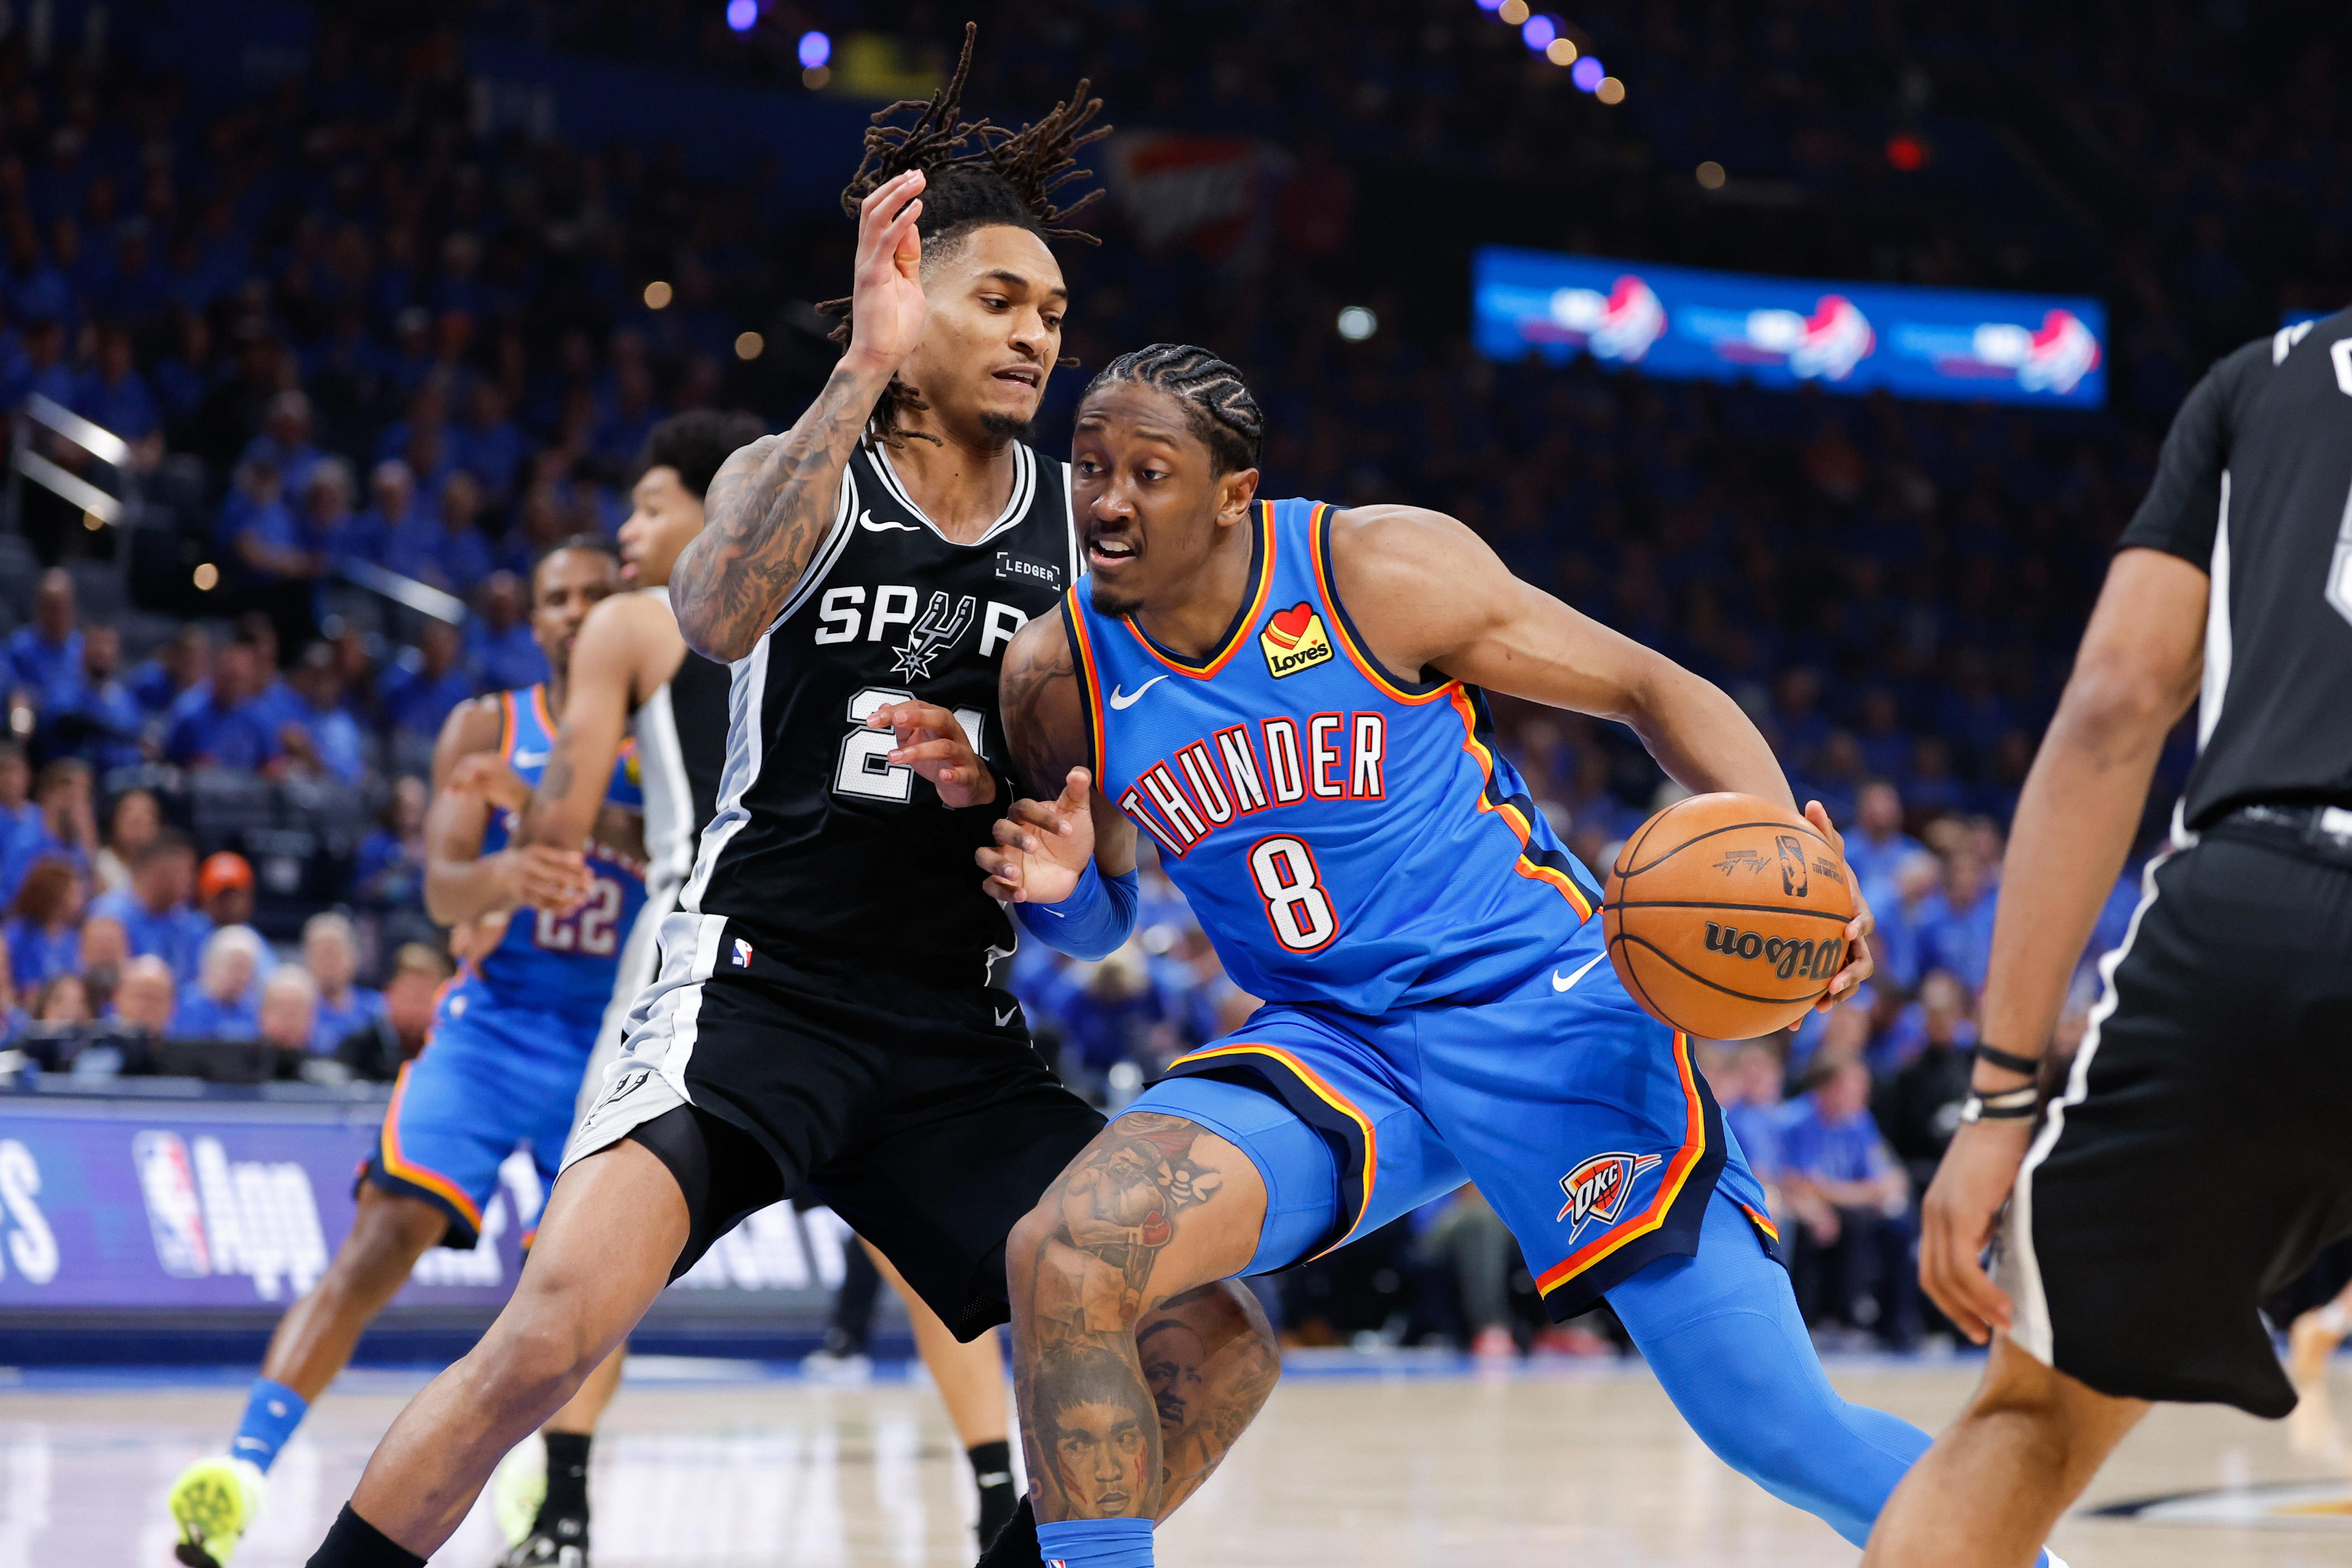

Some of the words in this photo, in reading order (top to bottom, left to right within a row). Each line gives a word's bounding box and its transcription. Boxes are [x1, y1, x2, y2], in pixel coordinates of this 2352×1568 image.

[1005, 559, 1054, 582] LEDGER
[814, 585, 1030, 684] SPUR
[1117, 711, 1387, 860] THUNDER
[1246, 833, 1339, 954] 8
[1704, 920, 1842, 980] Wilson
[1574, 1163, 1619, 1221] OKC
